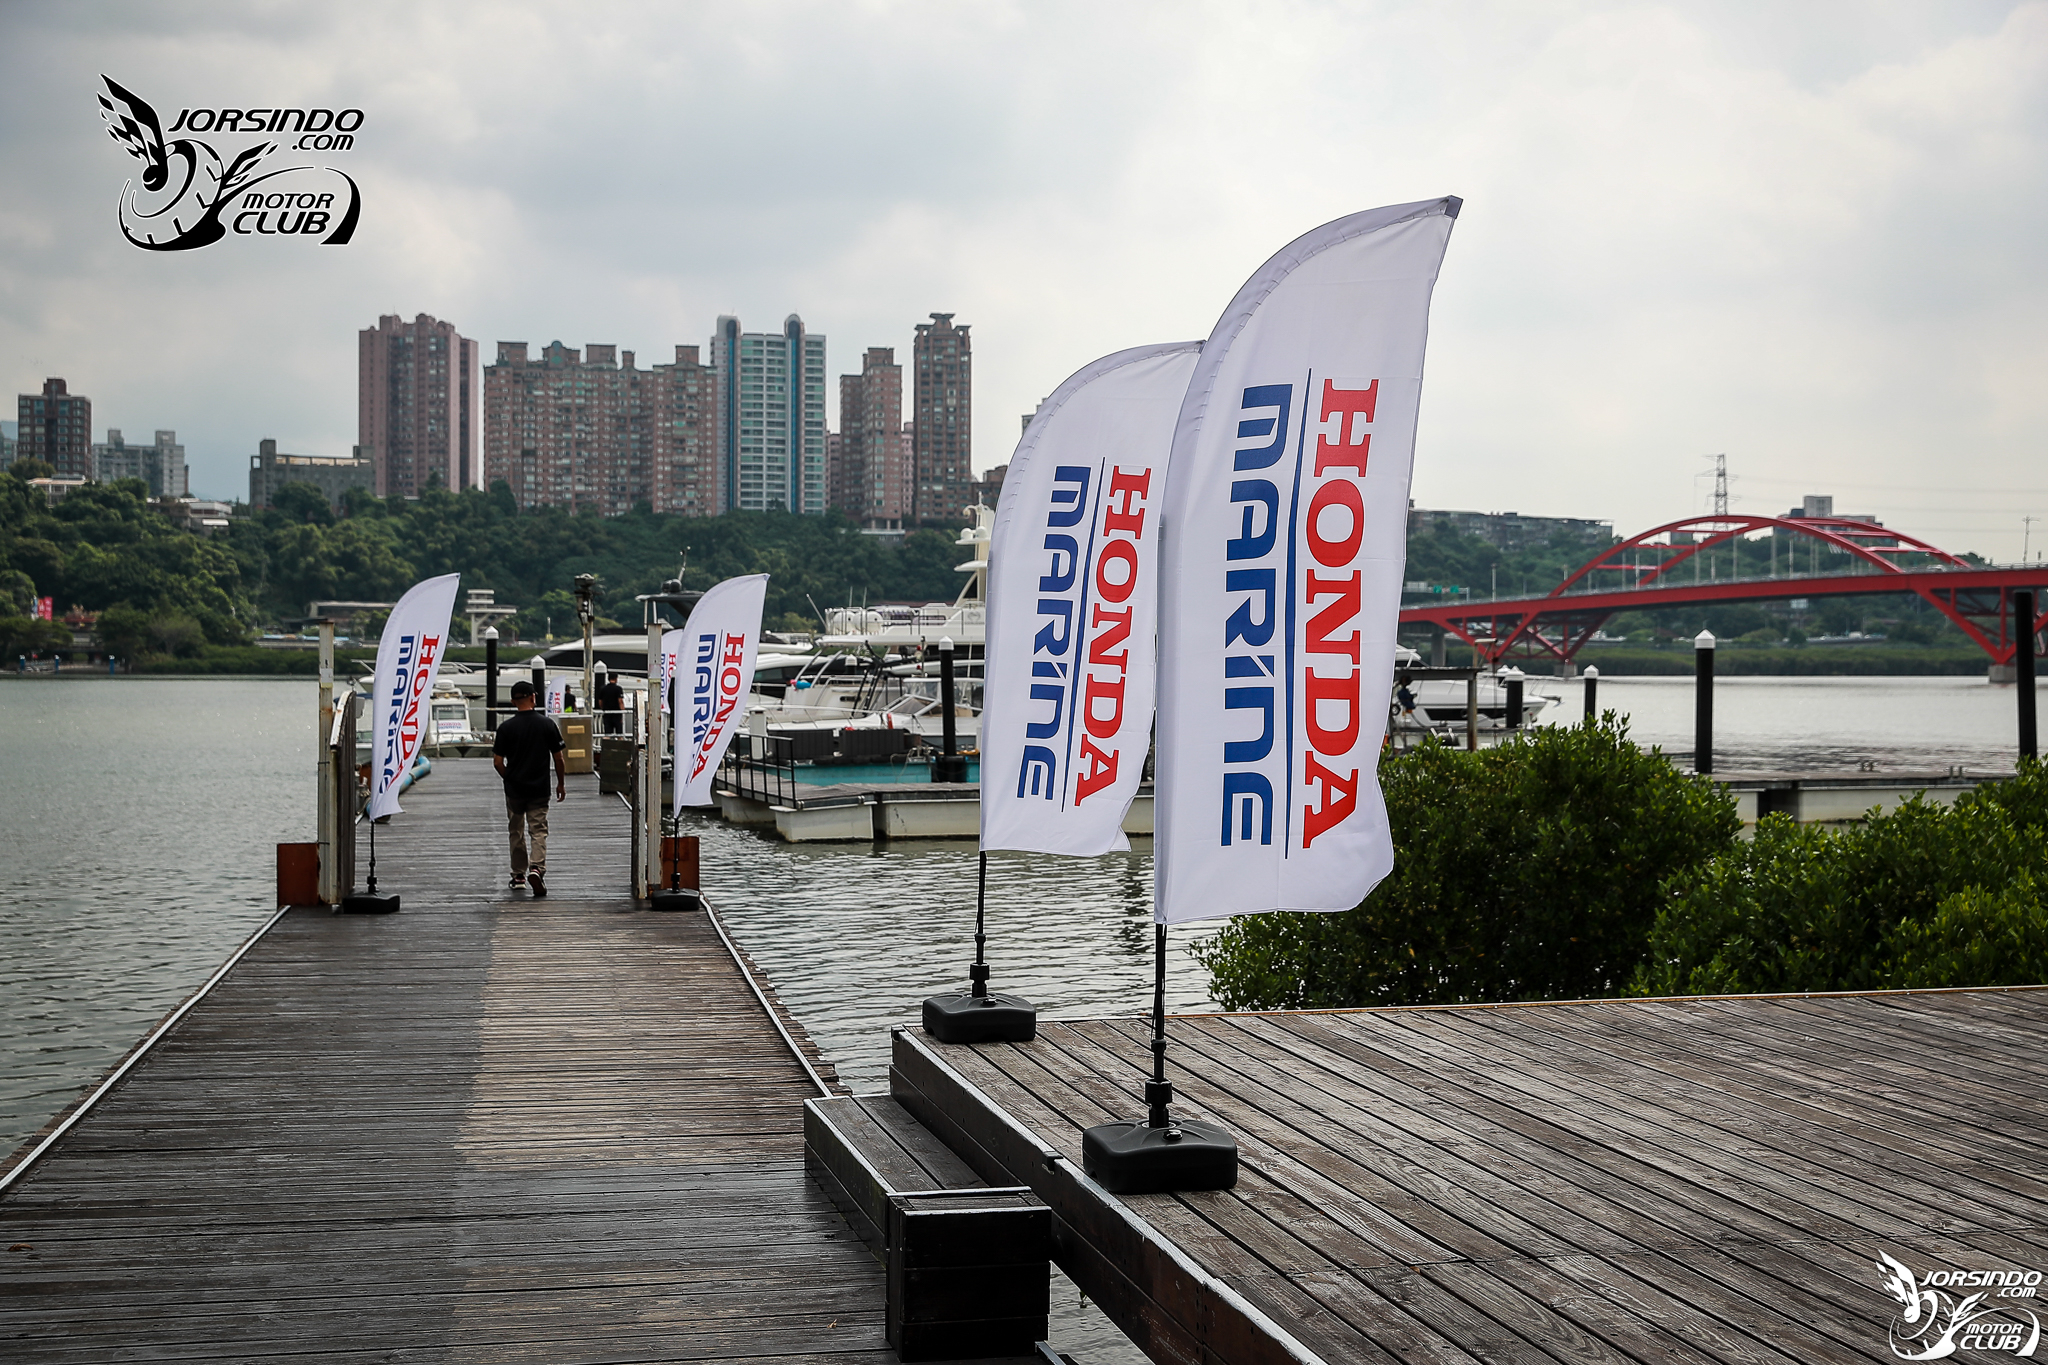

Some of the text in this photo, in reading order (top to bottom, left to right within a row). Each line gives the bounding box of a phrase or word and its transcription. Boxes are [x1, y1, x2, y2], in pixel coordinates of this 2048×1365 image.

[690, 632, 746, 783] HONDA
[1017, 465, 1091, 801] MARINE
[1074, 465, 1152, 807] HONDA
[1220, 383, 1294, 847] MARINE
[1302, 378, 1380, 850] HONDA
